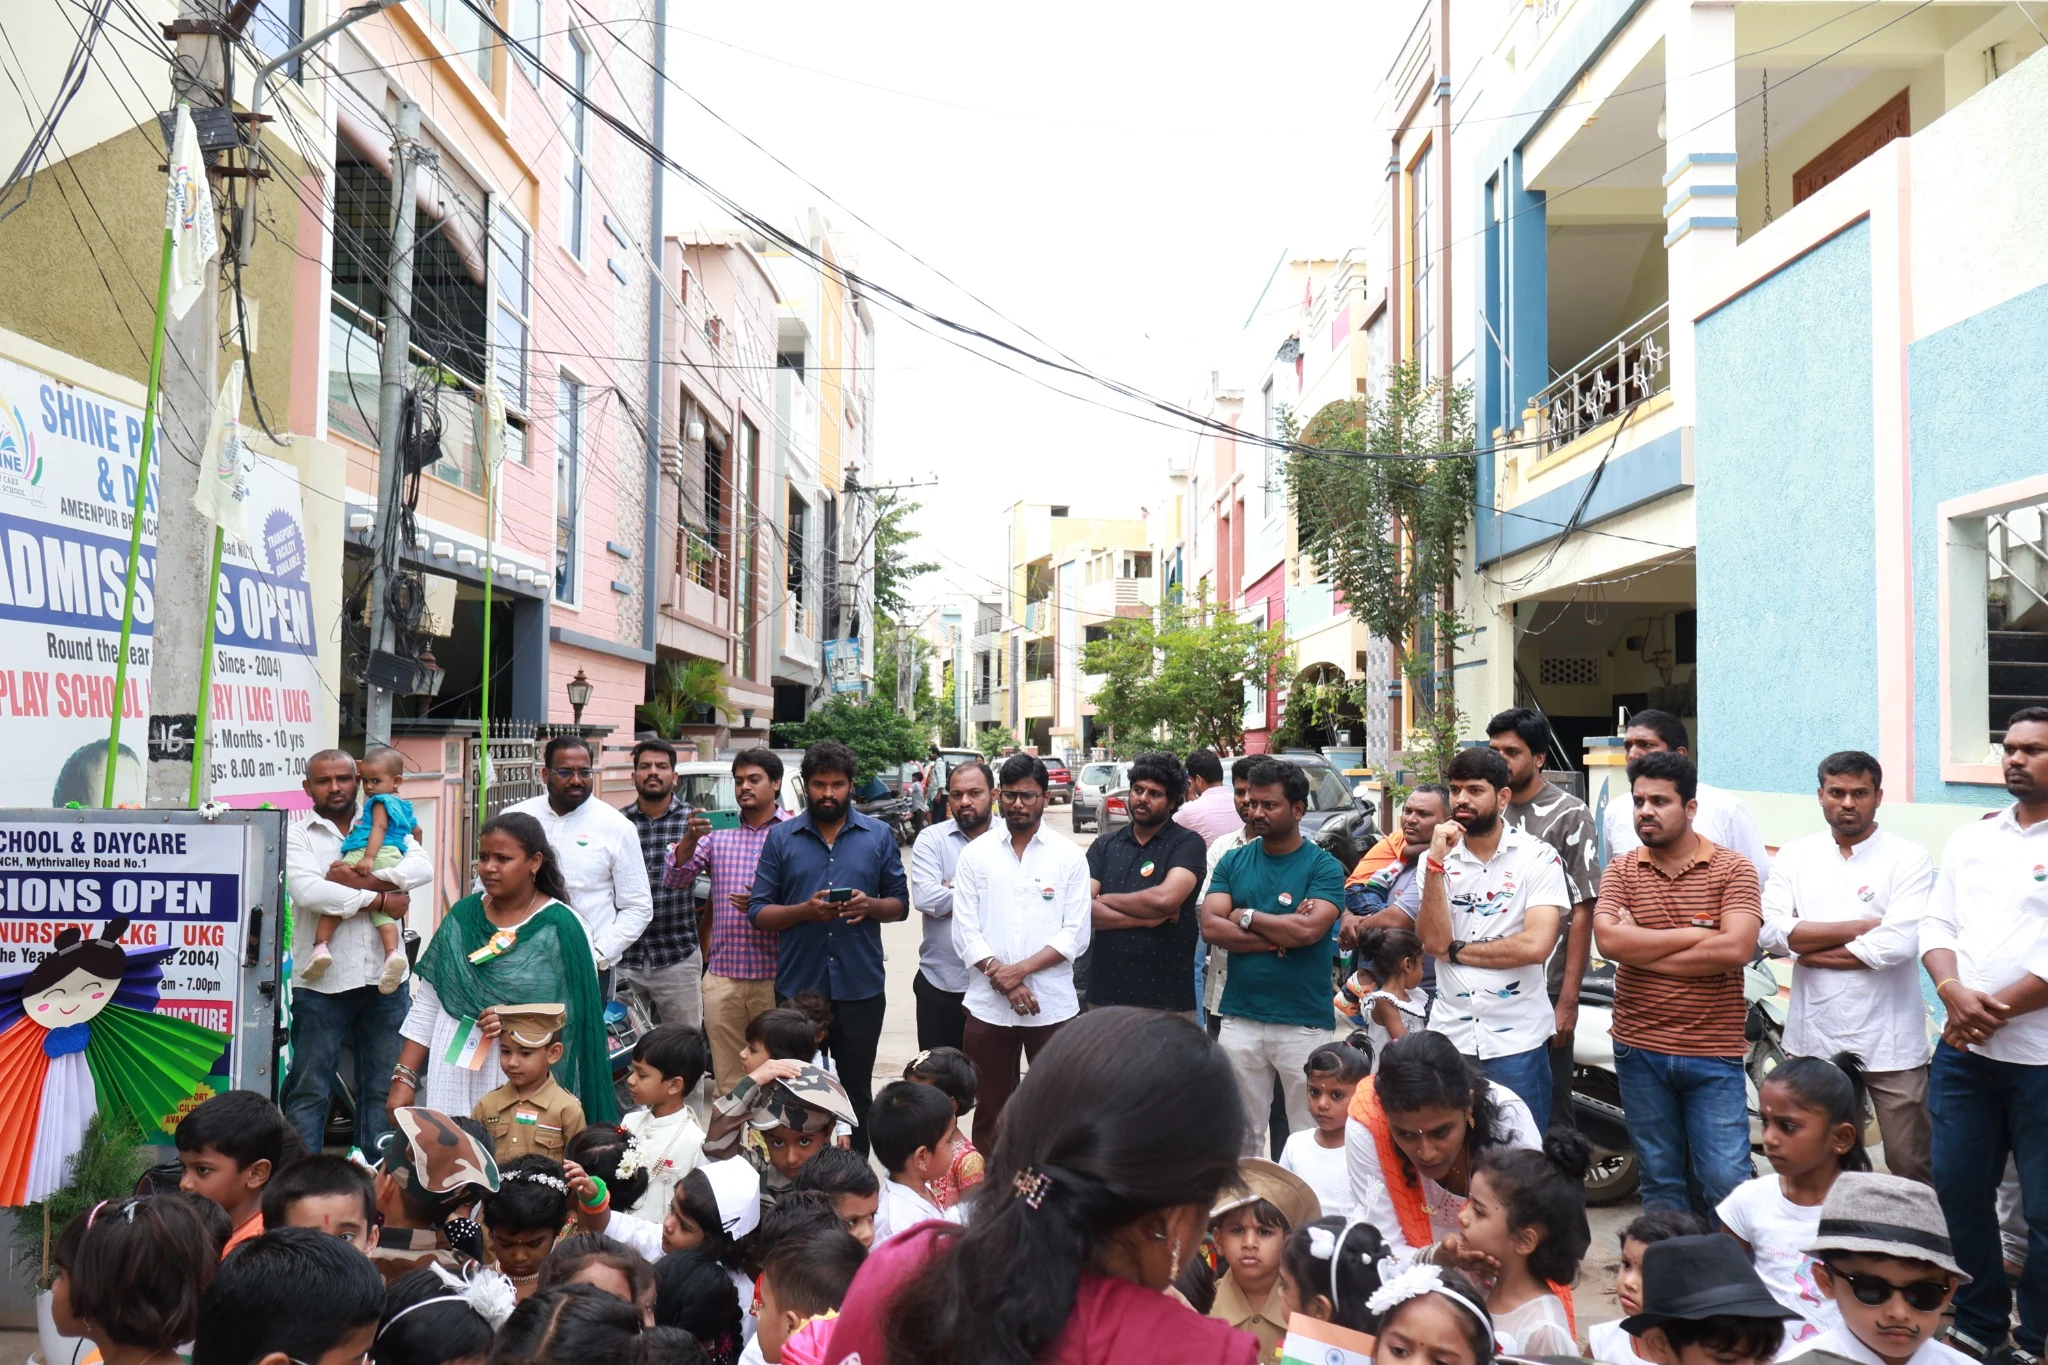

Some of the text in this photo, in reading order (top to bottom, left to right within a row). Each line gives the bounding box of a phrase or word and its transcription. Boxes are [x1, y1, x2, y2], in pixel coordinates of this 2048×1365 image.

[39, 384, 120, 453] SHINE
[2, 485, 27, 497] SCHOOL
[97, 456, 117, 504] &
[60, 497, 119, 528] AMEENPUR
[267, 524, 296, 548] TRANSPORT
[274, 539, 297, 561] FACILITY
[276, 553, 301, 578] AVAILABLE
[239, 577, 311, 646] OPEN
[47, 632, 93, 661] Round
[97, 638, 119, 663] the
[126, 645, 150, 666] ear
[218, 650, 246, 675] Since
[255, 655, 282, 682] 2004)
[56, 672, 143, 718] SCHOOL
[244, 685, 274, 722] LKG
[282, 689, 312, 723] UKG
[221, 728, 263, 749] Months
[274, 730, 287, 748] 10
[291, 732, 305, 752] yrs
[230, 758, 255, 779] 8.00
[258, 762, 275, 777] am
[71, 831, 86, 854] &
[93, 832, 187, 855] DAYCARE
[26, 857, 91, 870] Mythrivalley
[93, 857, 120, 868] Road
[124, 858, 147, 868] No.1
[0, 878, 212, 914] IONS OPEN
[183, 924, 224, 946] UKG
[179, 949, 219, 970] 2004)
[161, 980, 176, 991] am
[187, 977, 221, 994] 7.00pm
